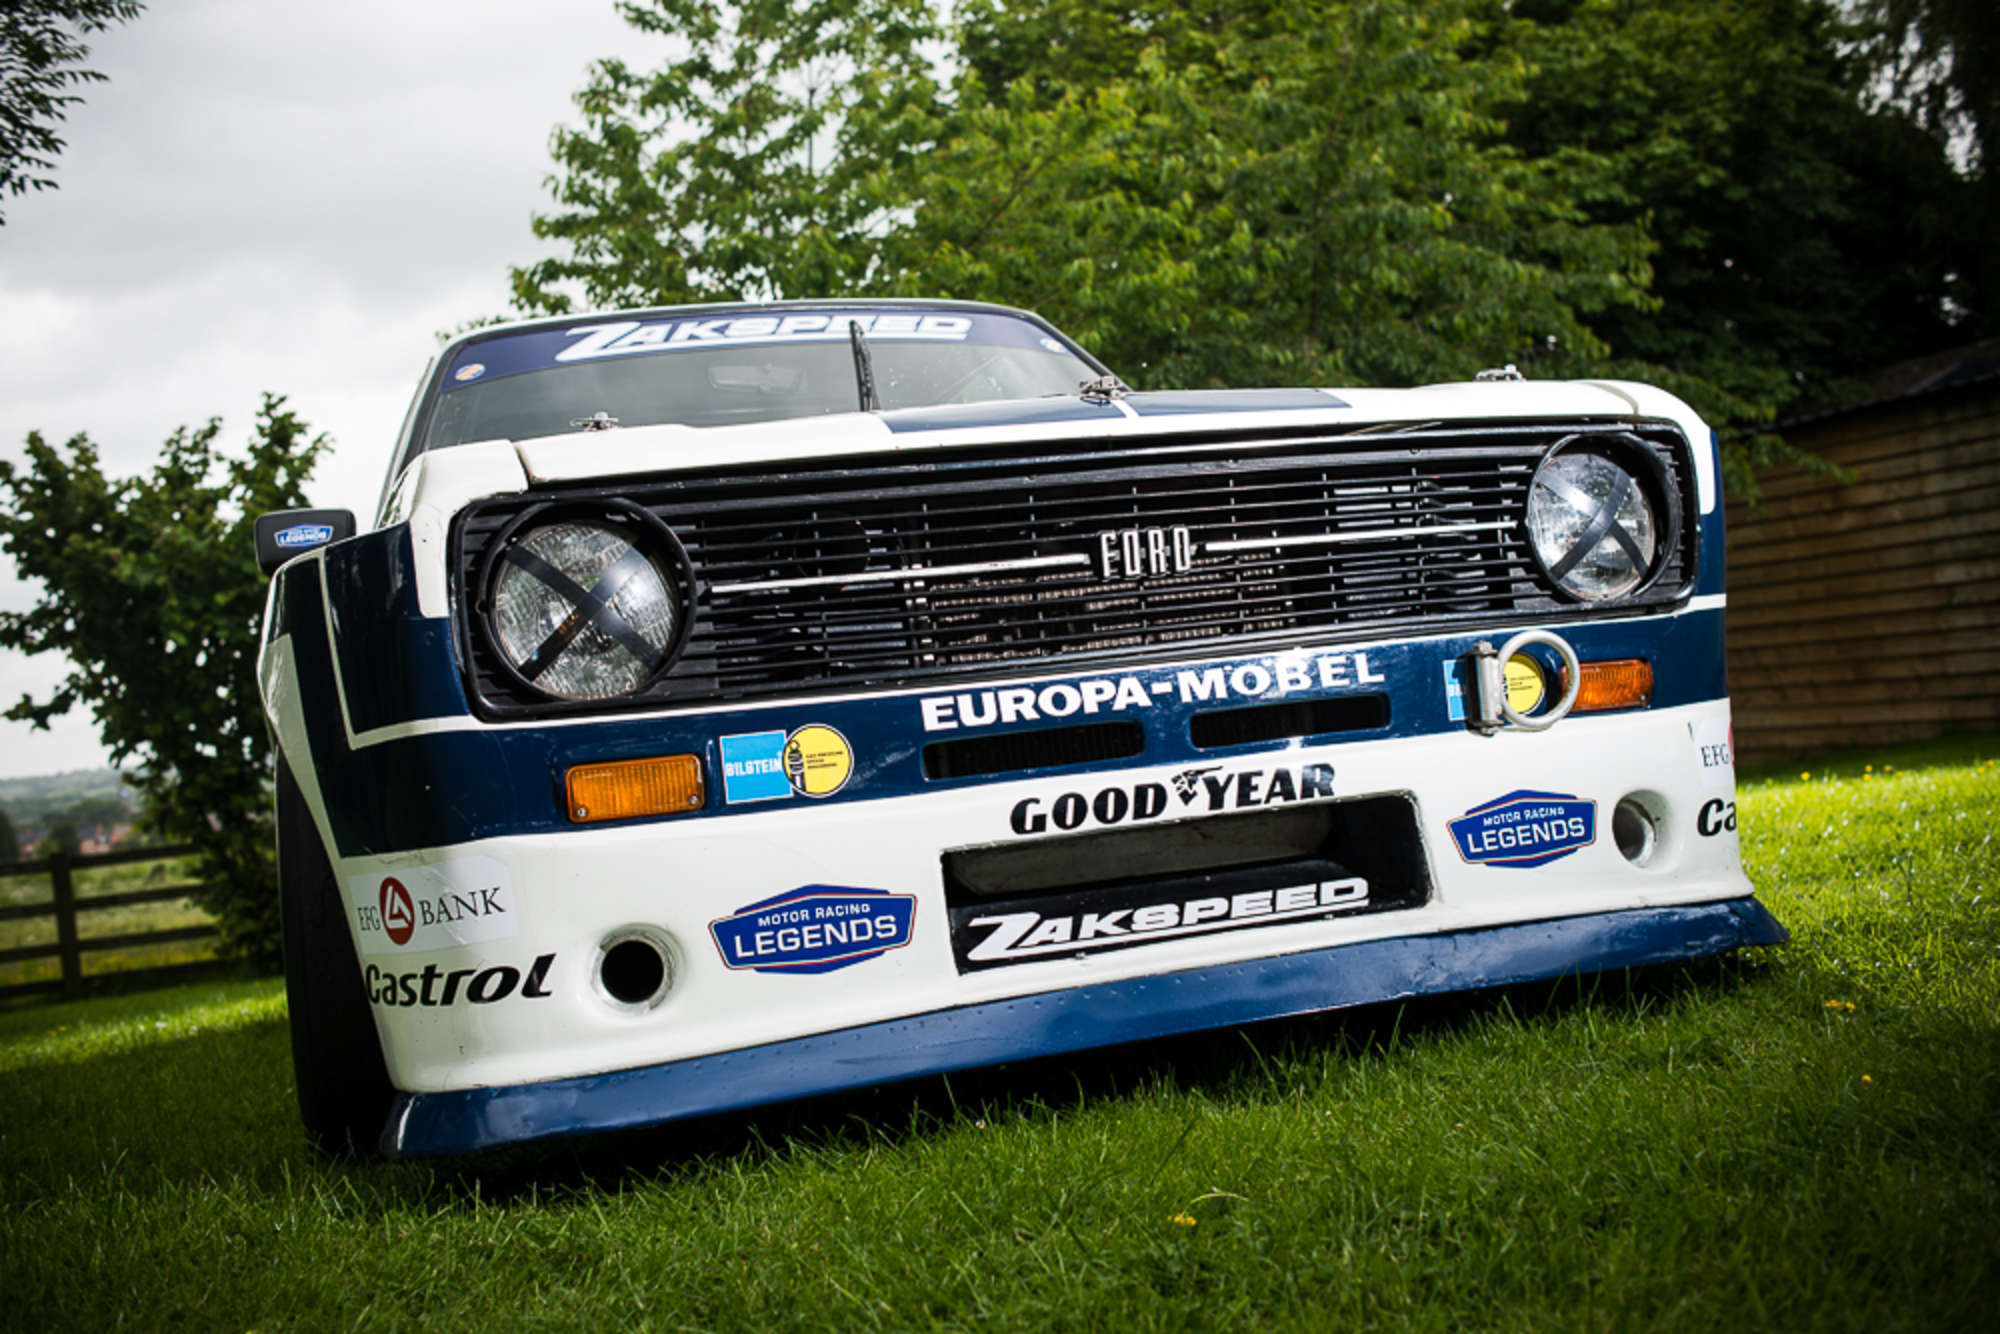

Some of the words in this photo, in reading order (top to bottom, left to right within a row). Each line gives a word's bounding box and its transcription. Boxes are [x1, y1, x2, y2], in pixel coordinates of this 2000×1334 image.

[1101, 527, 1191, 578] FORD
[1467, 817, 1586, 854] LEGENDS
[1483, 811, 1521, 827] MOTOR
[1524, 806, 1565, 820] RACING
[357, 905, 381, 931] EFG
[419, 886, 506, 927] BANK
[758, 909, 810, 927] MOTOR
[816, 903, 871, 919] RACING
[967, 876, 1370, 961] ZAKSPEED
[734, 915, 898, 958] LEGENDS
[365, 952, 557, 1008] Castrol
